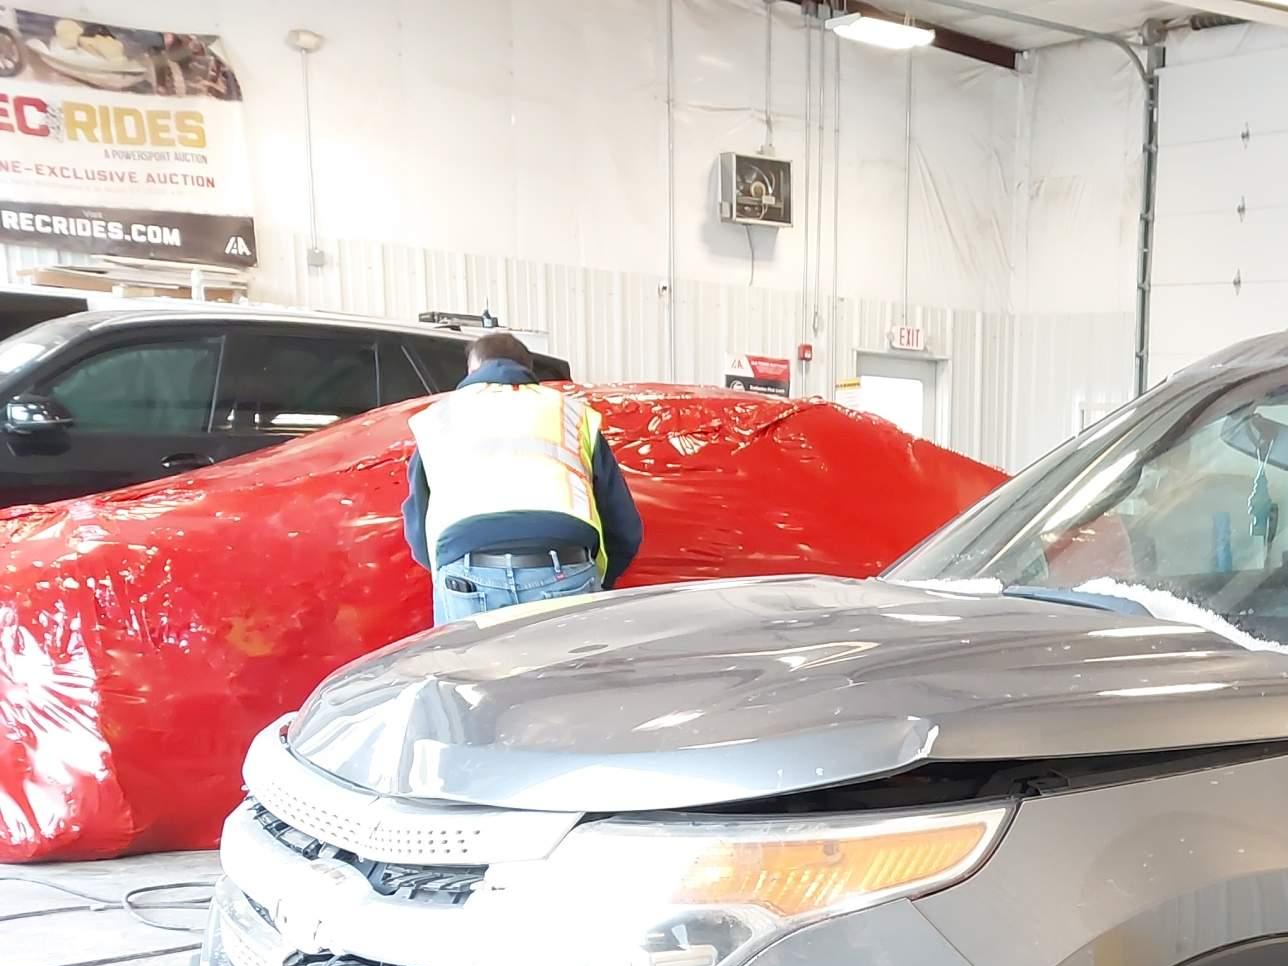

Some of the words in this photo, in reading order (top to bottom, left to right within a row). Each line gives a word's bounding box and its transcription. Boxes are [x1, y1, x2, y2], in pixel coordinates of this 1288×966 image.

[62, 101, 207, 148] RIDES
[174, 152, 208, 164] AUCTION
[146, 173, 215, 188] AUCTION
[1, 210, 181, 246] RECRIDES.COM
[900, 327, 920, 348] EXIT
